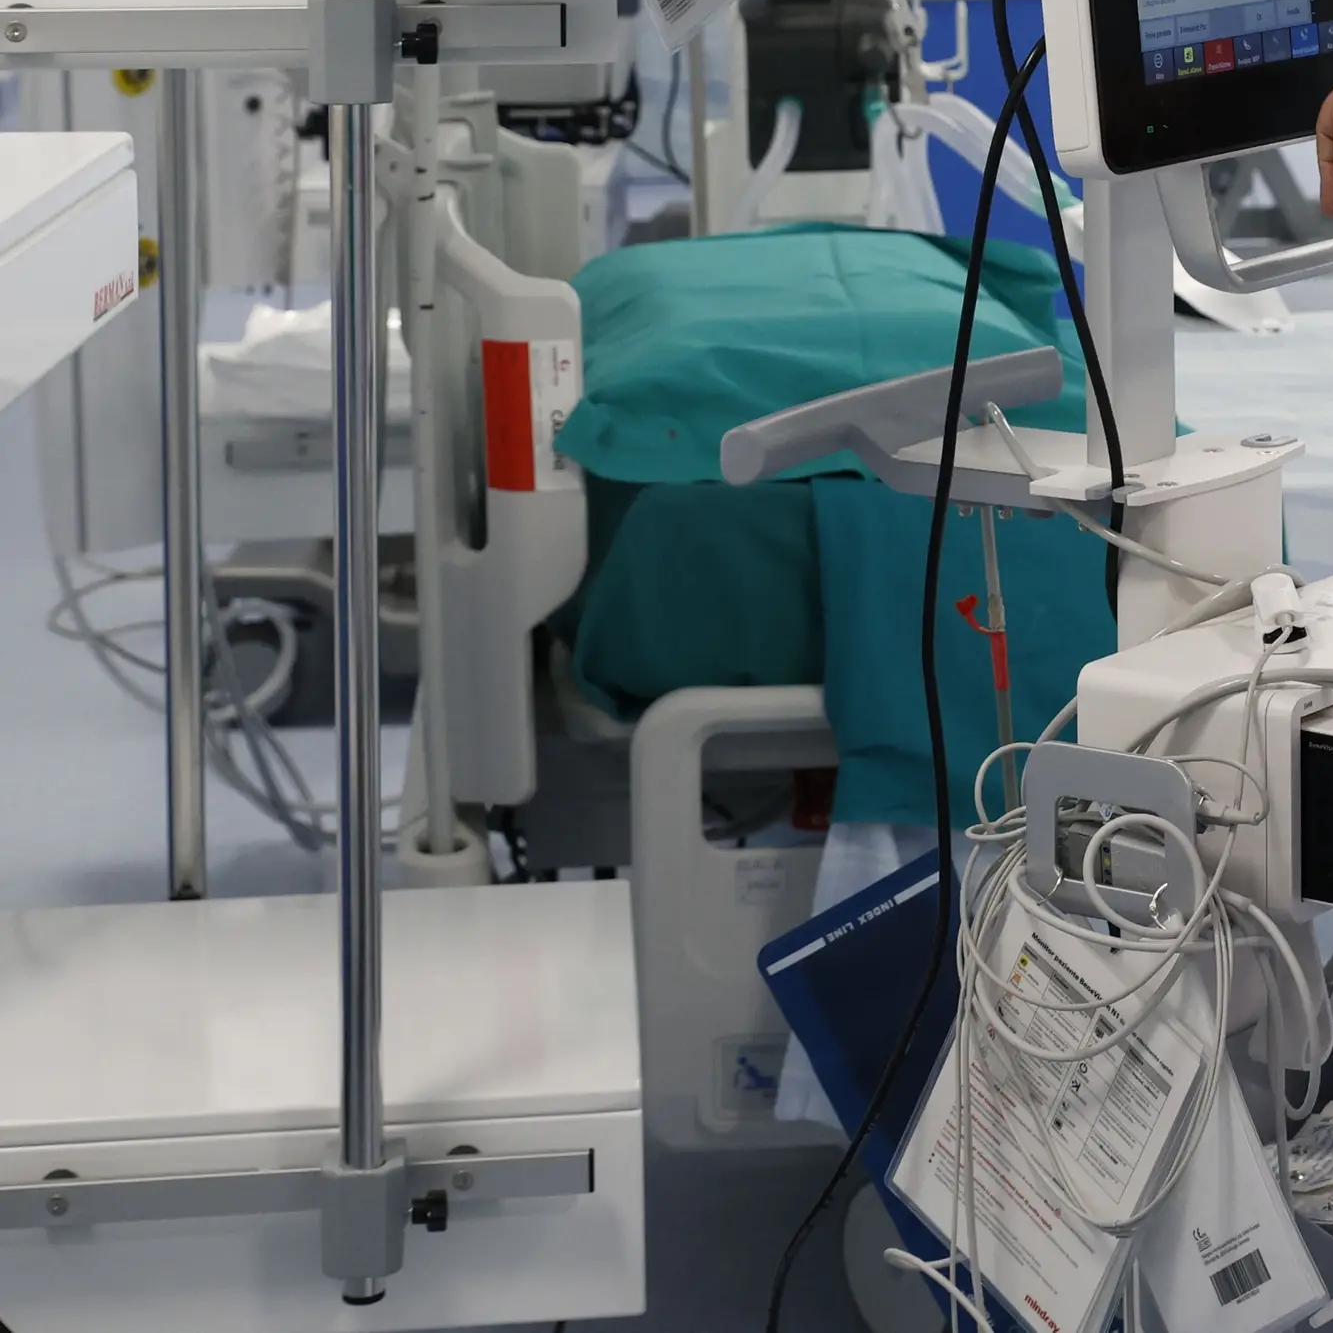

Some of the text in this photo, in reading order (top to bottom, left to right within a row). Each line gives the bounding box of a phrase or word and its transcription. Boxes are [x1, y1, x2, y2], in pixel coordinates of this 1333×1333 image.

[826, 899, 894, 943] INDEX LINE
[1031, 932, 1055, 956] Monitor
[1053, 954, 1080, 980] paziente
